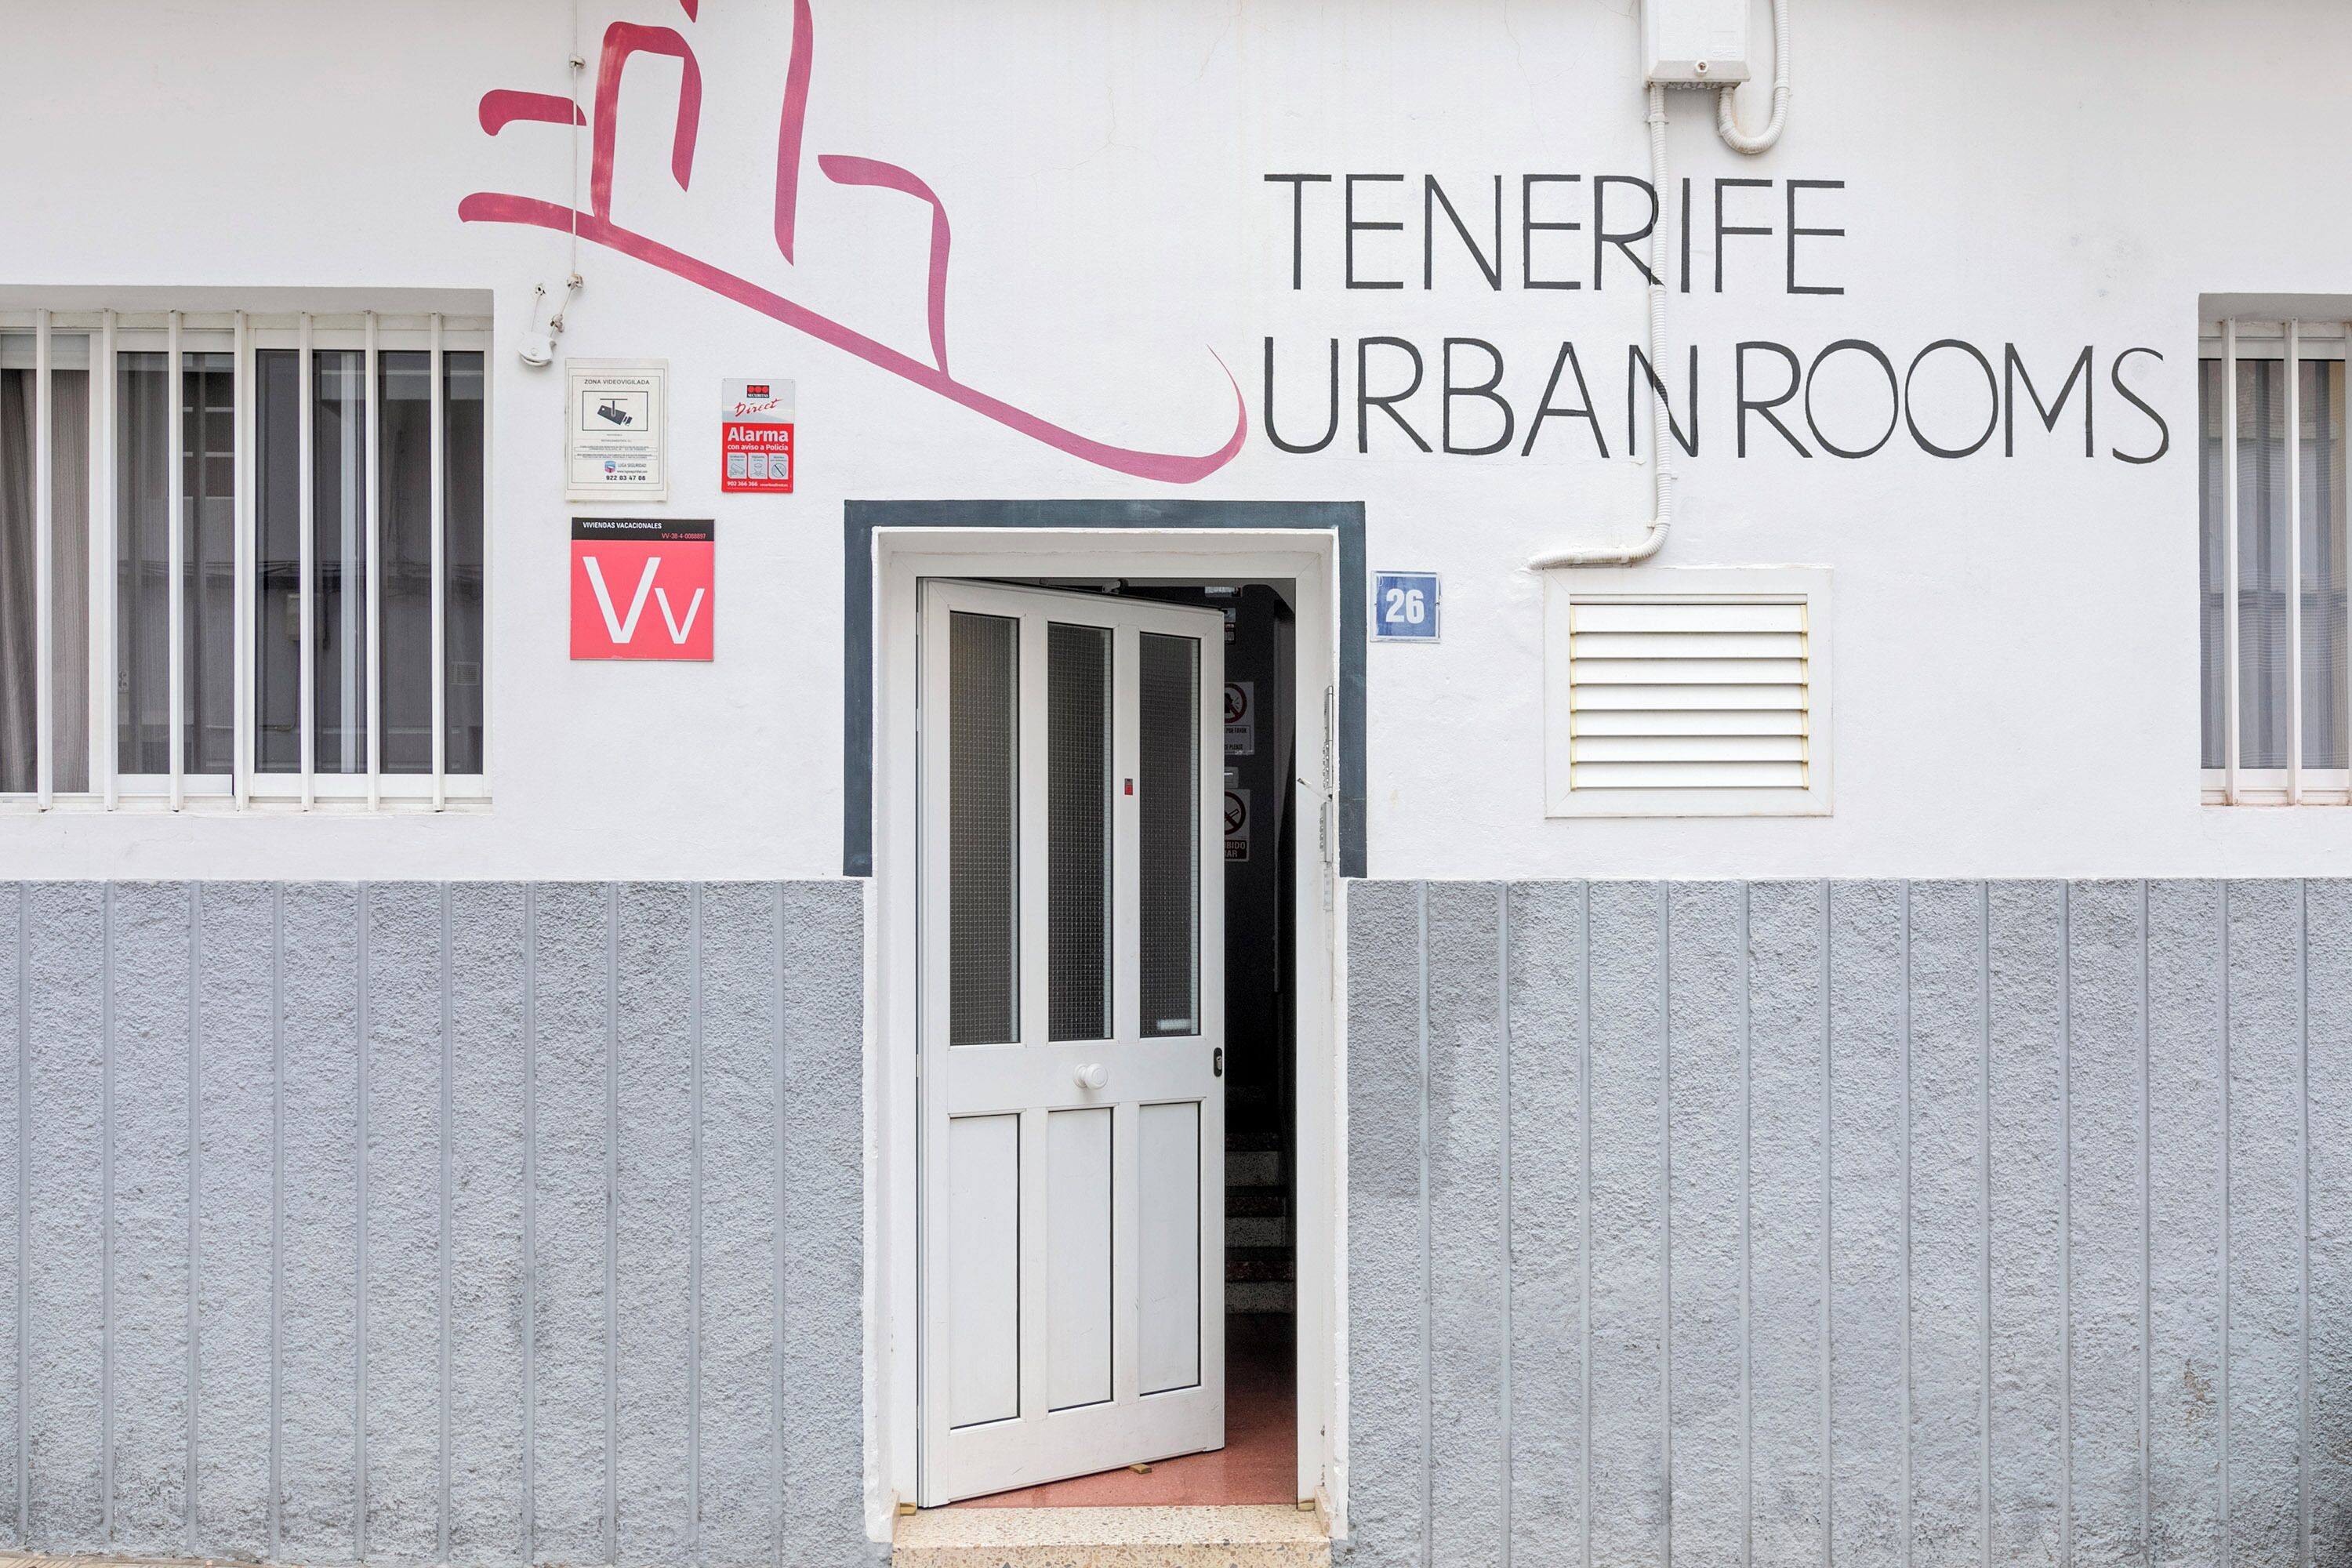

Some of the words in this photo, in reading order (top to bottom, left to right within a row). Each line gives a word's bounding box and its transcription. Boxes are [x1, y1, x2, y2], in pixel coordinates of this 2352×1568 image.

[1265, 173, 1845, 296] TENERIFE
[734, 398, 784, 417] Direct
[1265, 336, 1698, 459] URBAN
[1735, 339, 2170, 464] ROOMS
[728, 426, 789, 442] Alarma
[1385, 588, 1425, 624] 26
